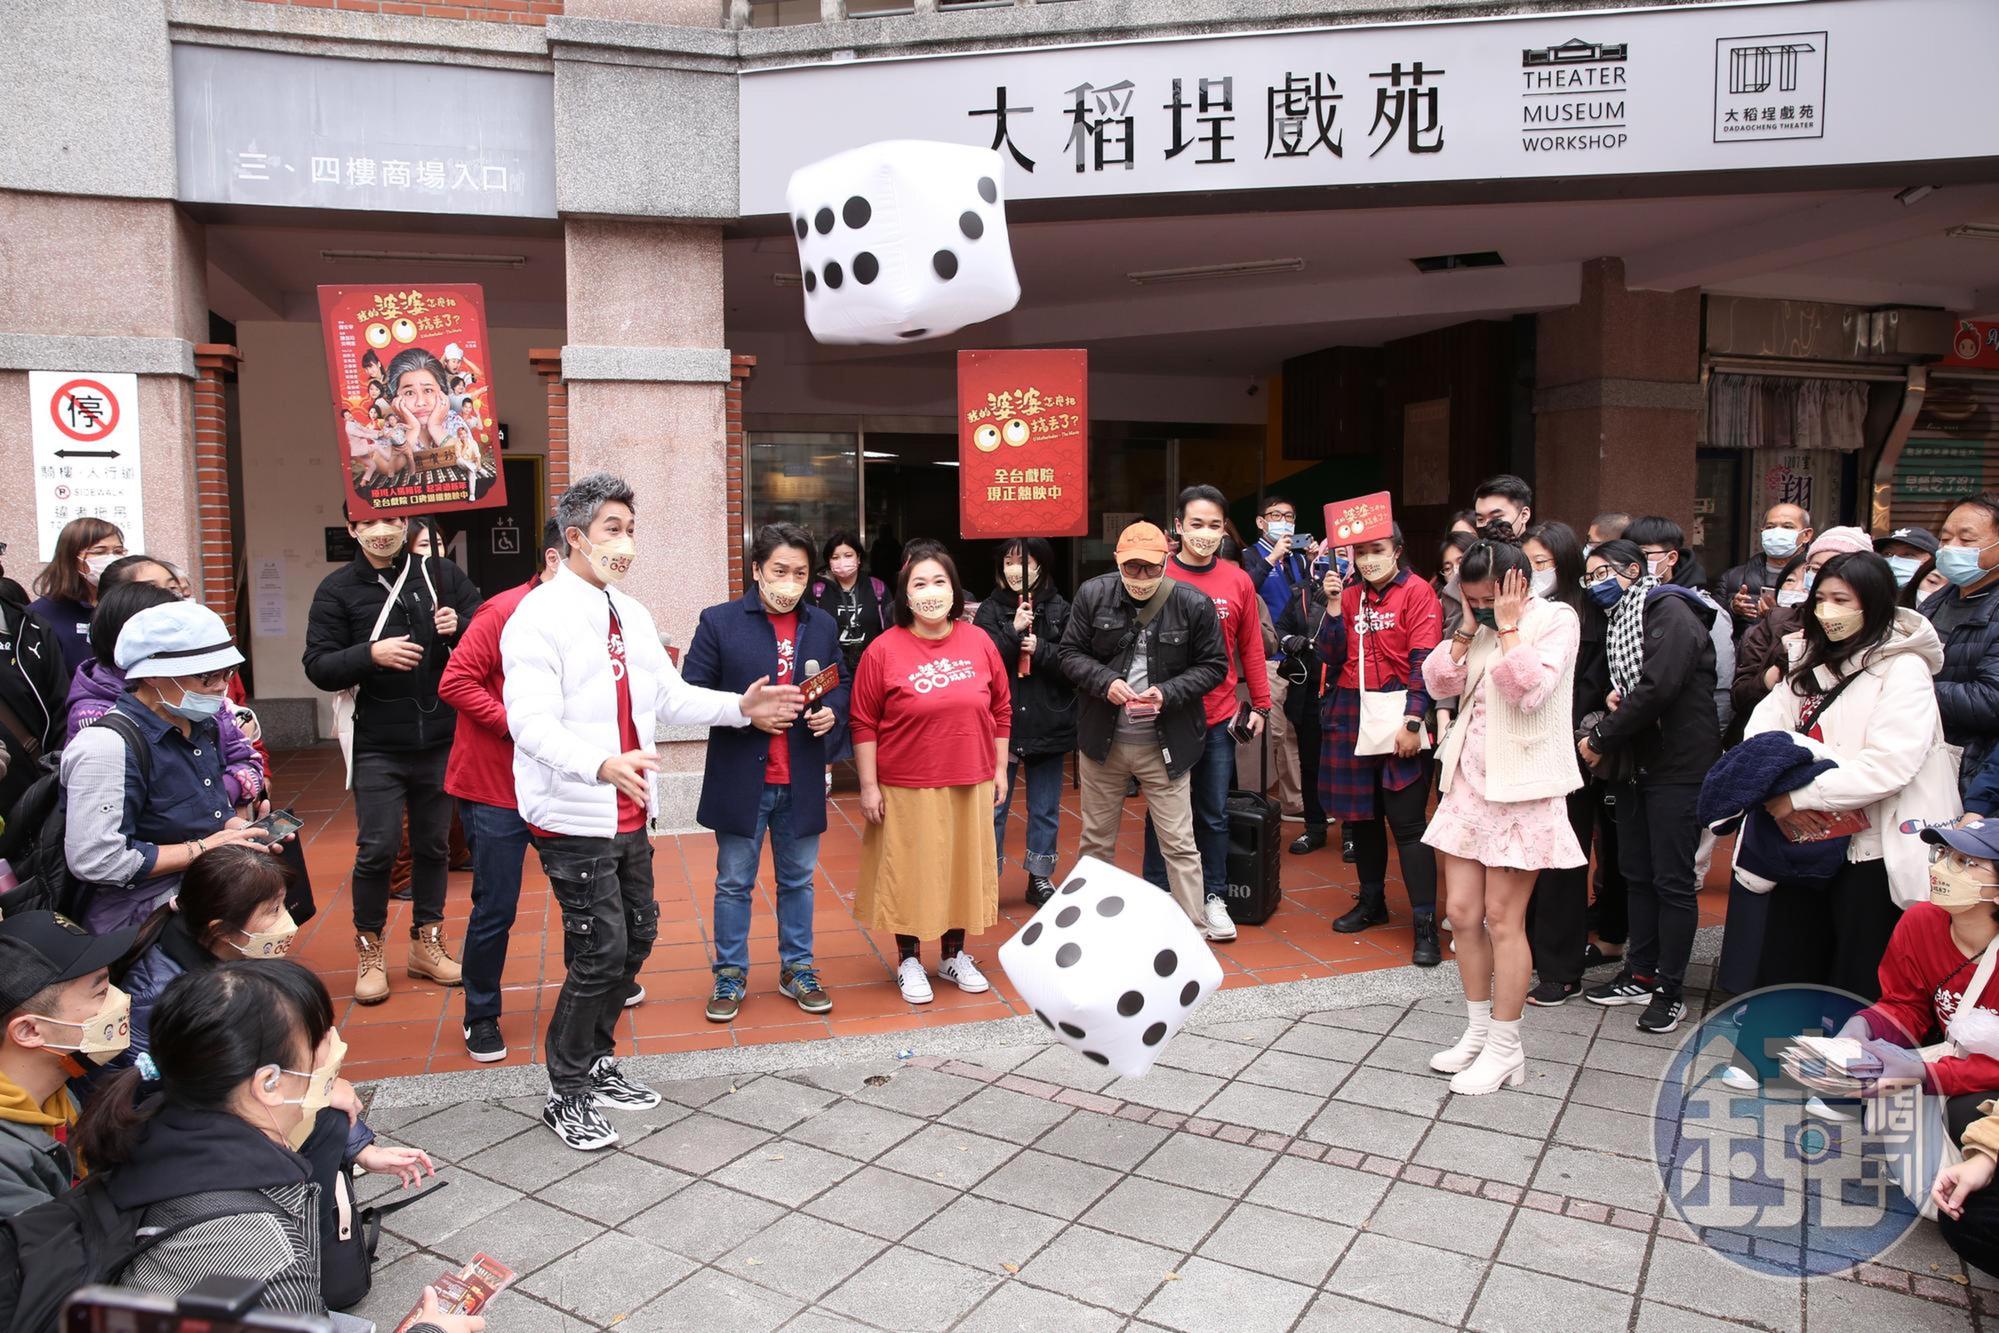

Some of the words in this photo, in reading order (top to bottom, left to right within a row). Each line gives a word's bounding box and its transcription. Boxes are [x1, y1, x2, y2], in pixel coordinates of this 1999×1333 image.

[1522, 66, 1627, 90] THEATER
[967, 62, 1446, 174] 大稻埕戲苑
[1522, 101, 1625, 123] MUSEUM
[1724, 104, 1815, 123] 大稻埕戲苑
[1723, 123, 1778, 133] DADAOCHENG
[1779, 120, 1815, 130] THEATER
[1522, 133, 1628, 152] WORKSHOP
[238, 152, 508, 193] 三、四樓商場入口
[67, 394, 104, 428] 停
[994, 467, 1055, 484] 全台戲院
[73, 488, 125, 497] SIDEWALK
[986, 485, 1062, 502] 現正熱映中
[1780, 474, 1813, 511] 翔
